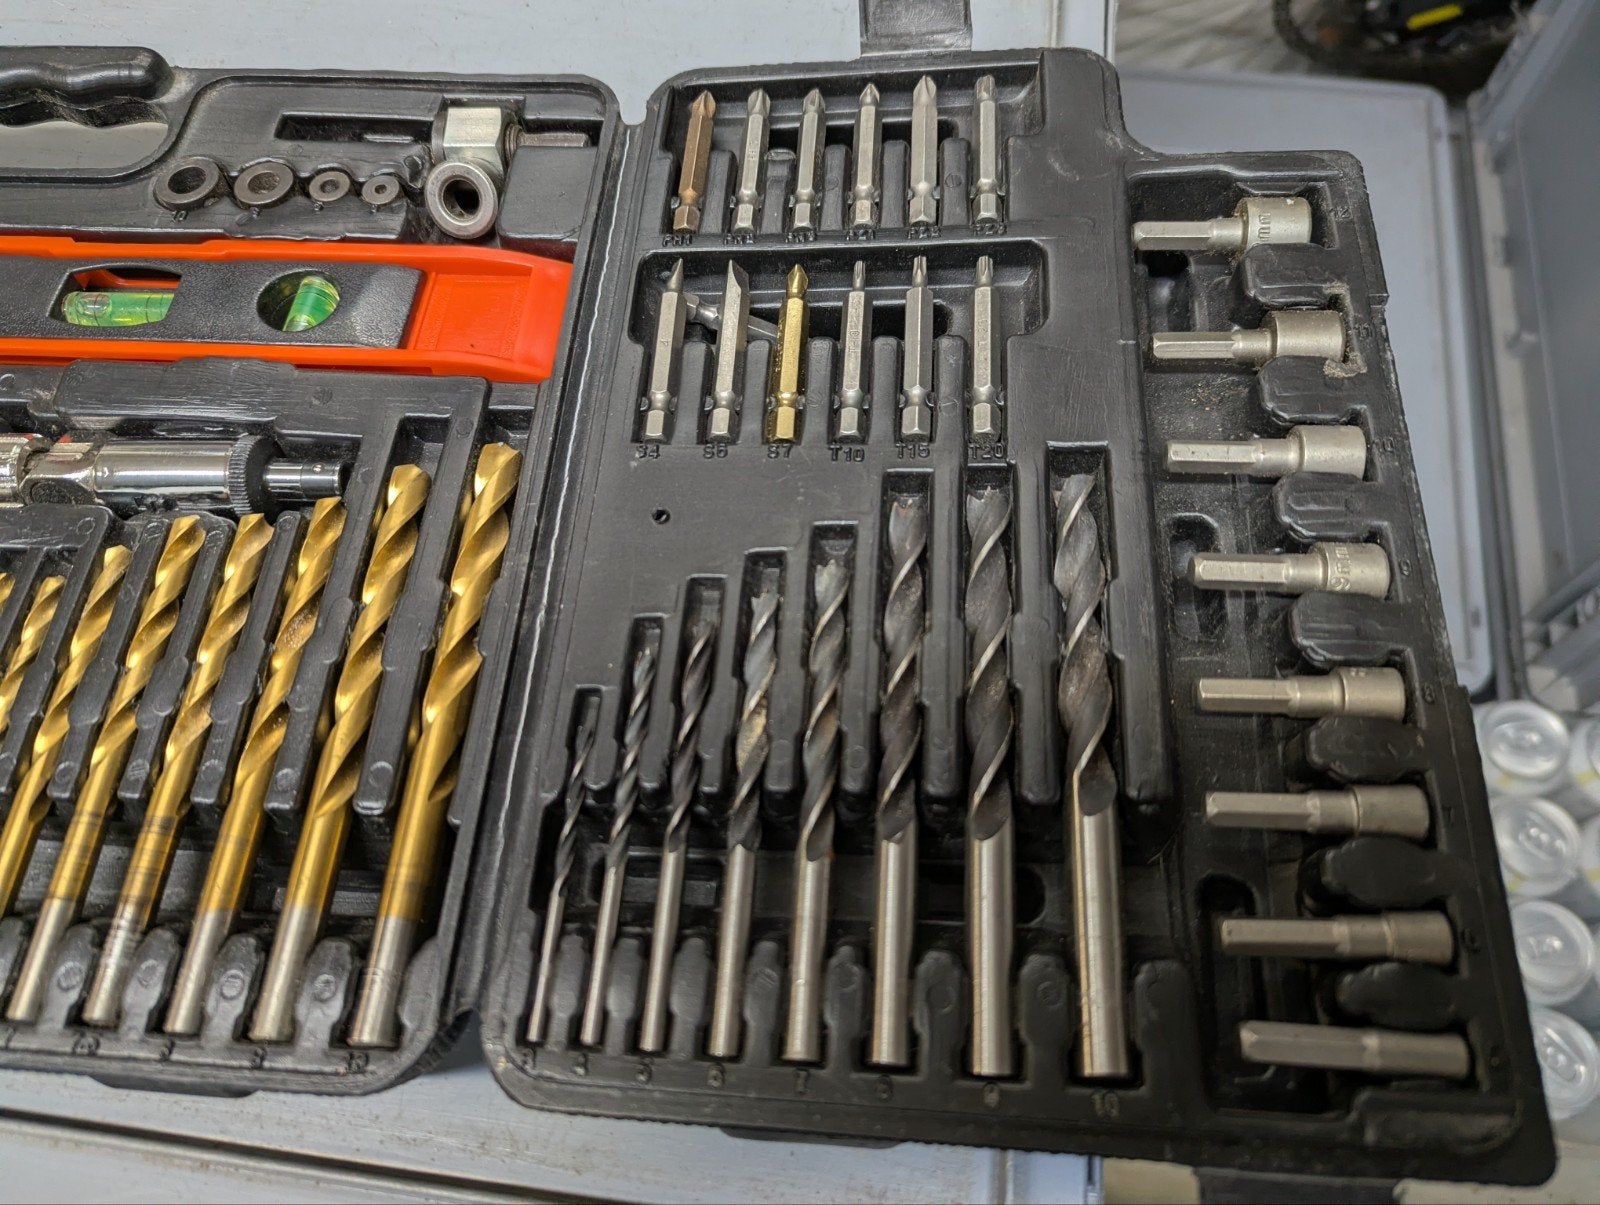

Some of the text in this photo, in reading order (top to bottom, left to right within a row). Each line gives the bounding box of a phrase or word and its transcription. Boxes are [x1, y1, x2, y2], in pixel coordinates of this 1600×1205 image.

[662, 233, 693, 247] PH1
[636, 443, 661, 459] S4
[766, 443, 795, 459] S7
[828, 442, 866, 462] T10
[894, 441, 931, 459] T15
[968, 442, 1007, 460] T20
[1089, 1089, 1121, 1119] 10
